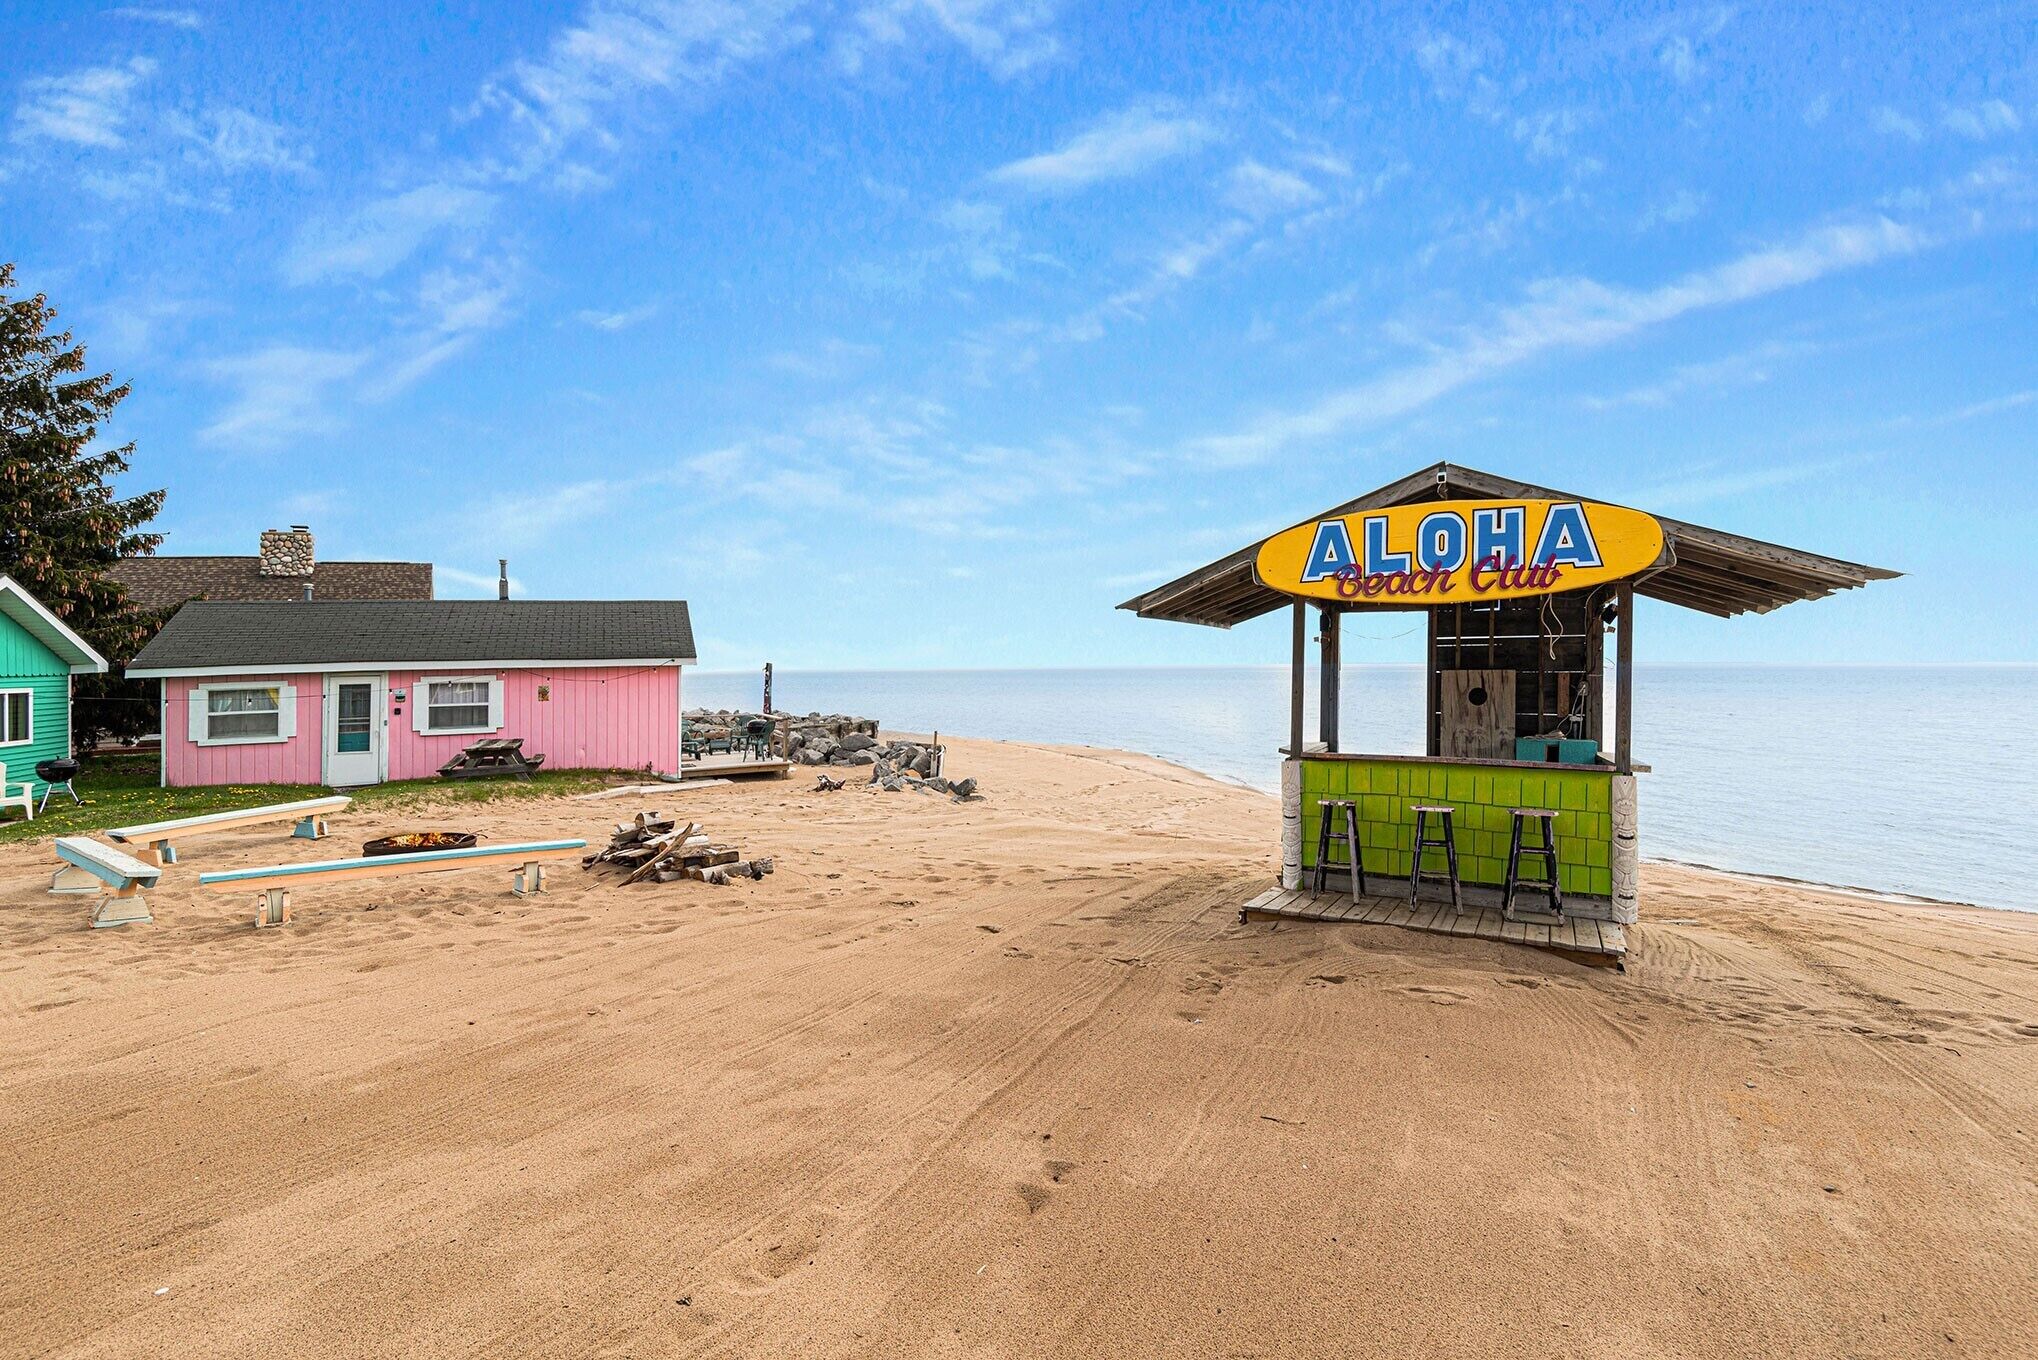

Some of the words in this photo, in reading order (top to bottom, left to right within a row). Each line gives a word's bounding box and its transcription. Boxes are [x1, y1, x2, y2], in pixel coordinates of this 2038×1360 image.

[1300, 501, 1604, 583] ALOHA
[1334, 561, 1457, 598] Beach
[1471, 553, 1563, 590] Club
